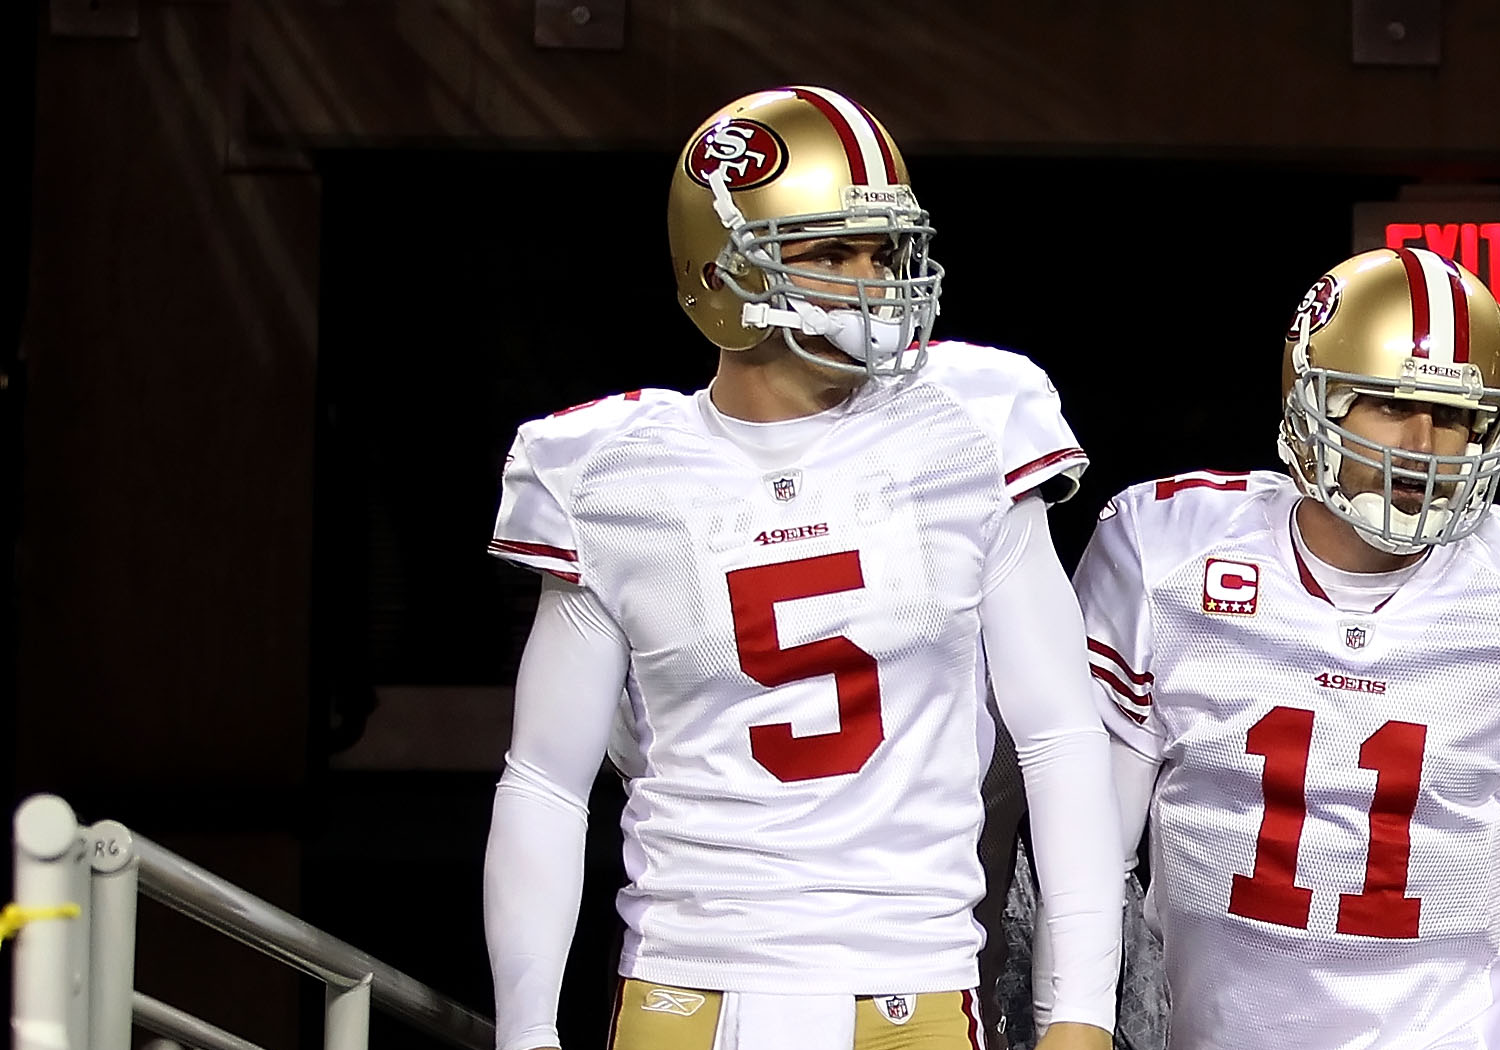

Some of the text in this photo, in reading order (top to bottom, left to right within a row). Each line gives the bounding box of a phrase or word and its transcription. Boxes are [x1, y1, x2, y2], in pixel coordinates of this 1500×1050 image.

[1418, 363, 1462, 379] 49ERS
[753, 522, 830, 546] 49ERS
[1205, 561, 1257, 603] C
[725, 549, 886, 783] 5
[1314, 672, 1387, 695] 49ERS
[1227, 705, 1428, 939] 11
